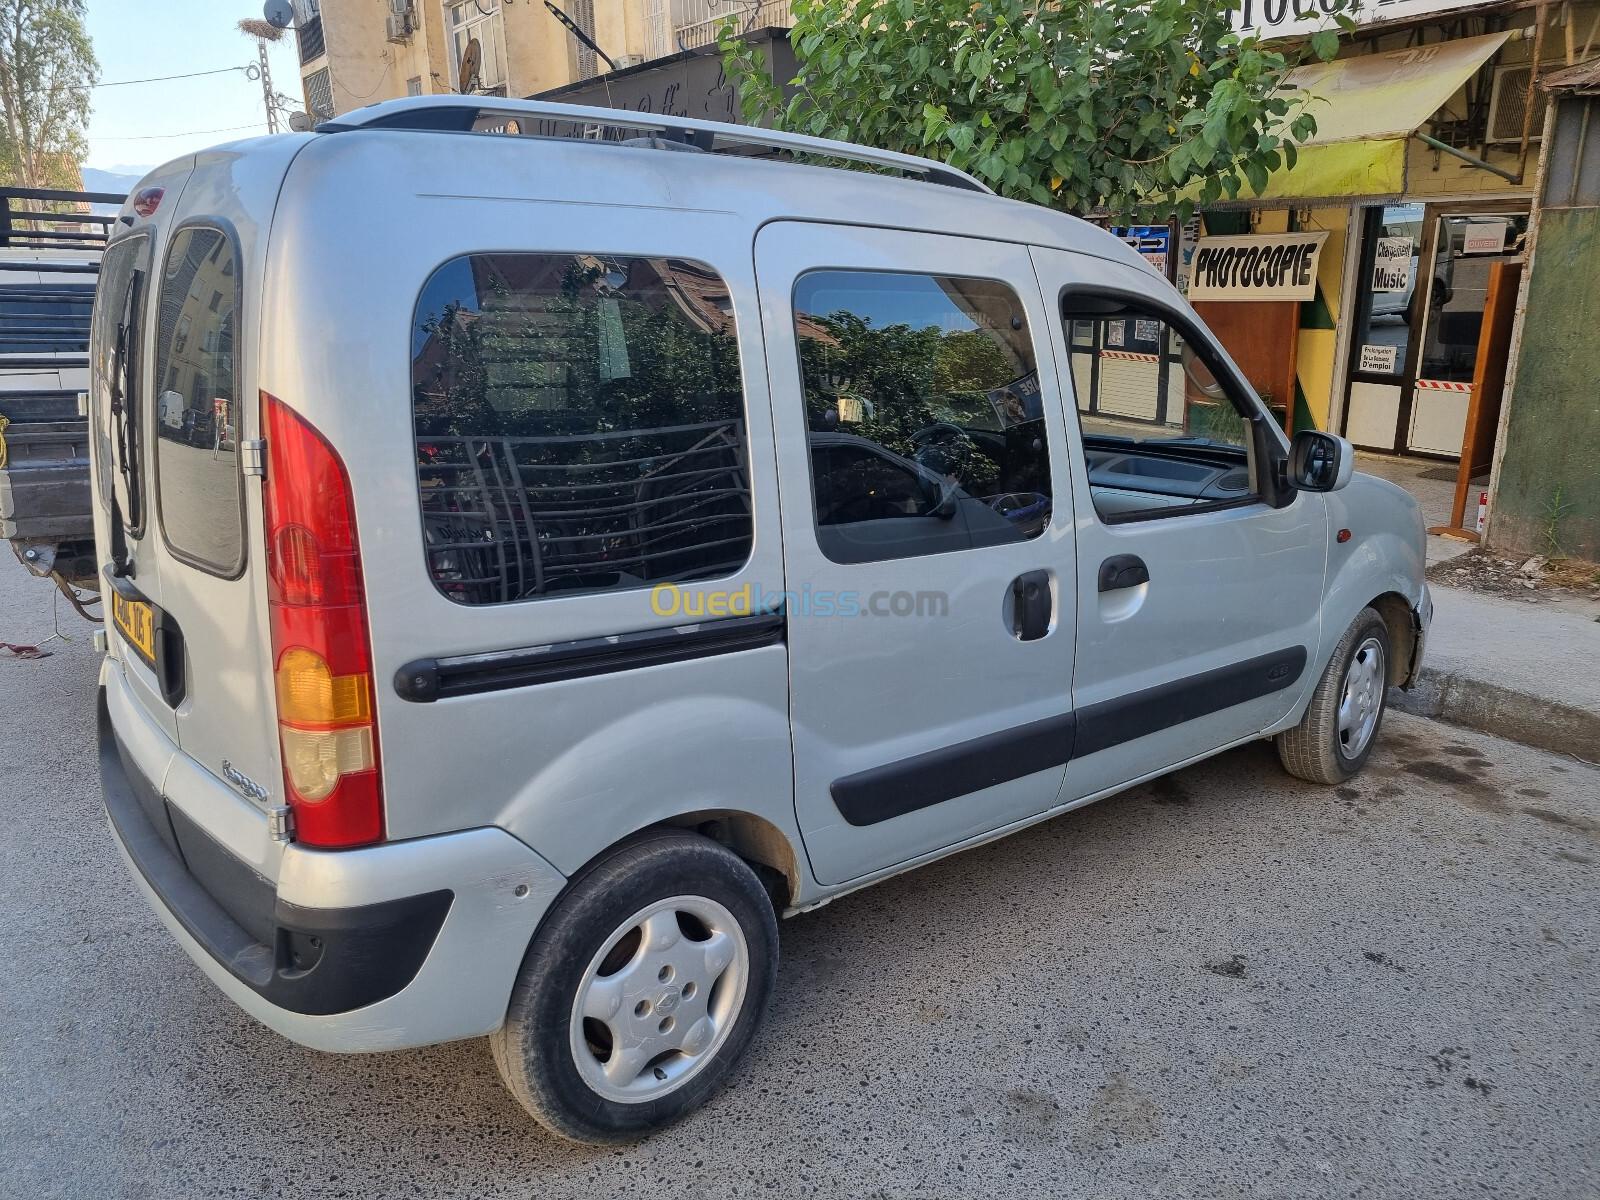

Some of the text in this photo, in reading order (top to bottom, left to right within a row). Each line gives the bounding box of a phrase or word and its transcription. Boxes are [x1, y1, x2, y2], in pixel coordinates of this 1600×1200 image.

[1194, 242, 1318, 288] PHOTOCOPIE
[1373, 267, 1407, 289] Music
[1362, 360, 1391, 370] D'emploi
